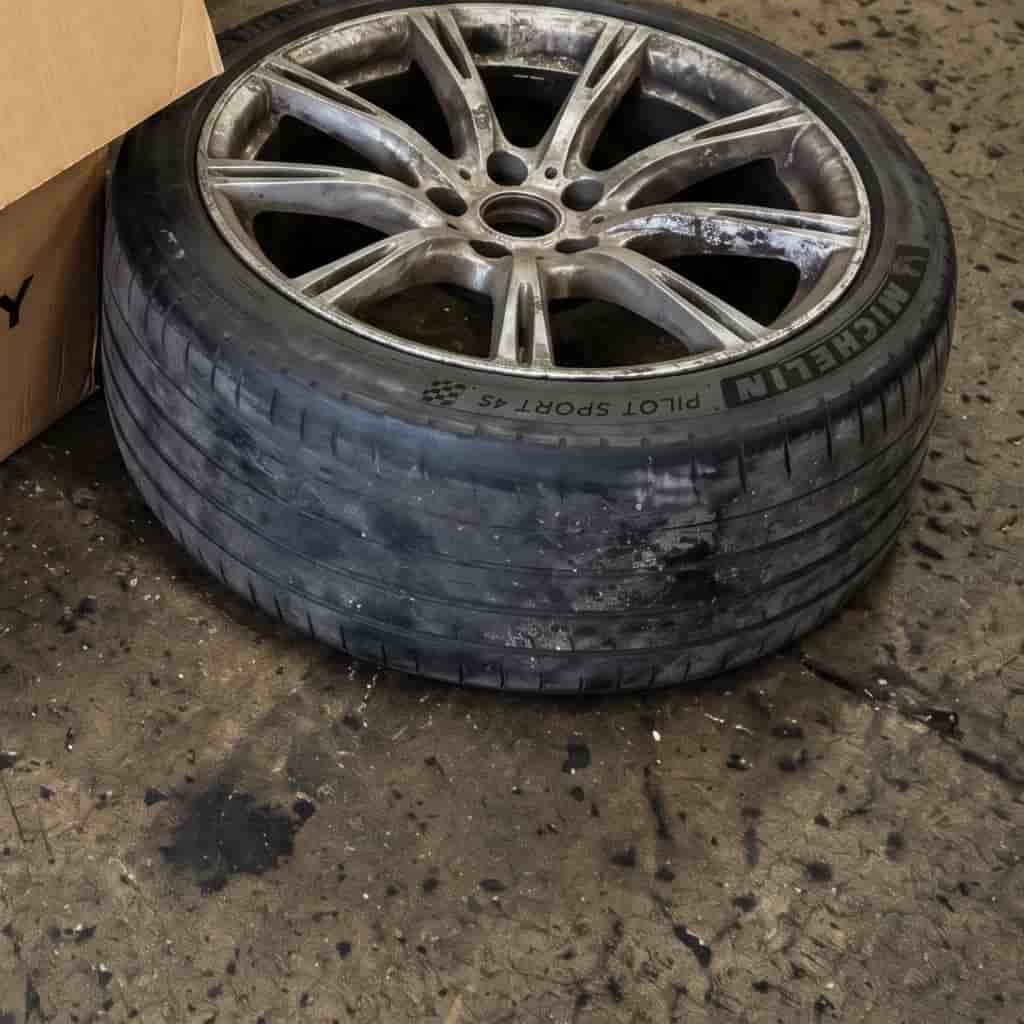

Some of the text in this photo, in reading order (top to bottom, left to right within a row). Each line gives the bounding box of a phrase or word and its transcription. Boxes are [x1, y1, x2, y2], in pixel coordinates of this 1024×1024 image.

[735, 280, 911, 402] MICHELIN
[478, 391, 701, 417] PILOT SPORT 4S
